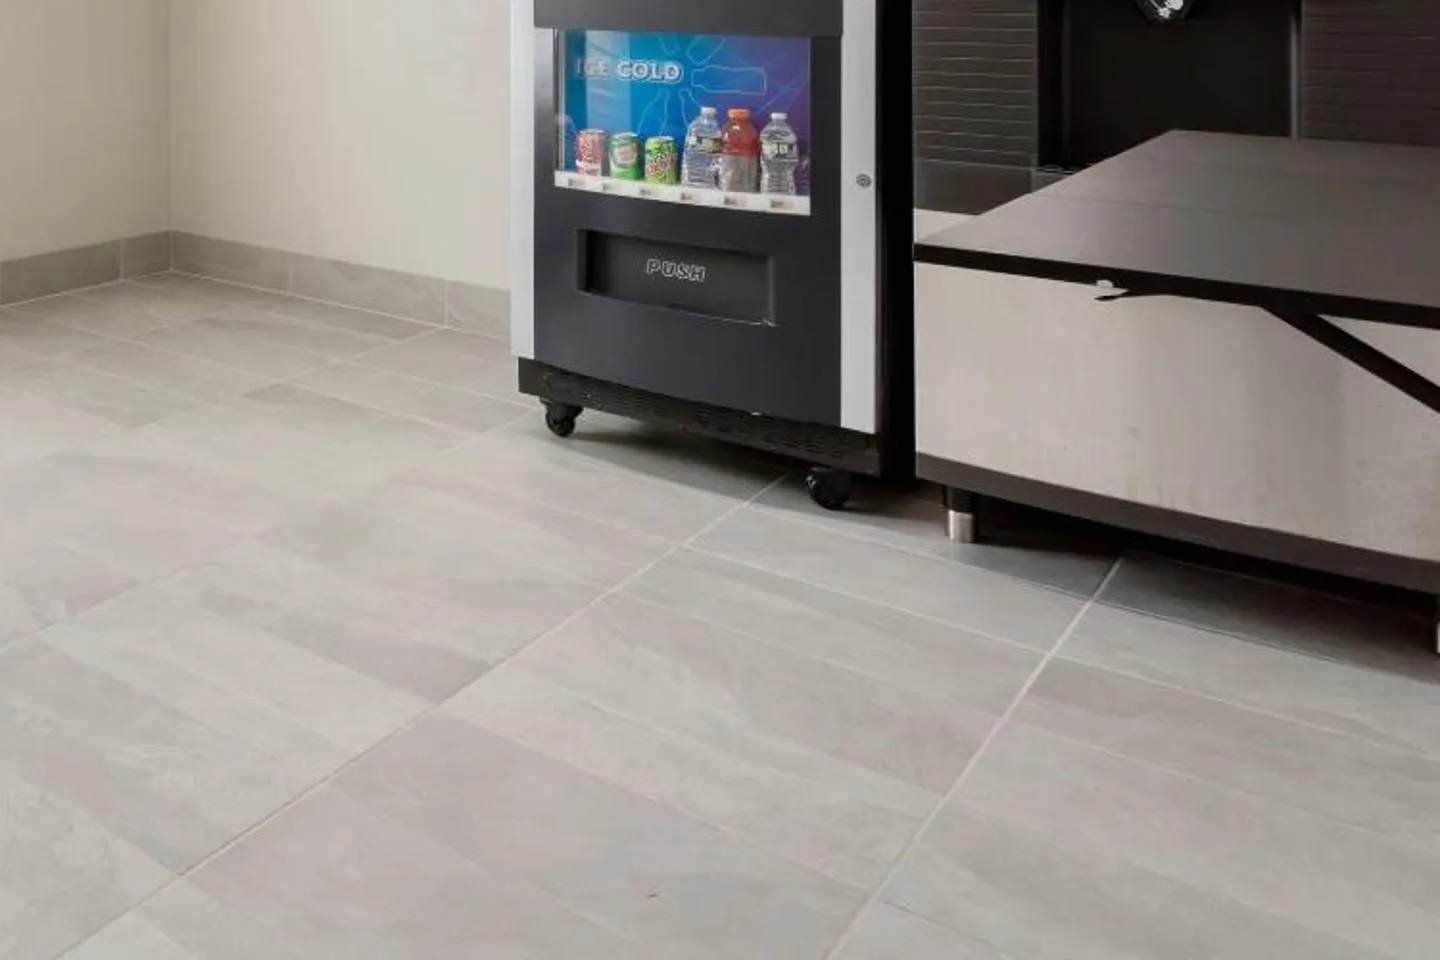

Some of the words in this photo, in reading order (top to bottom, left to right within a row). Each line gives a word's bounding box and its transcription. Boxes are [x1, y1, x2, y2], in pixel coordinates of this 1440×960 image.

[577, 59, 610, 77] ICE
[617, 60, 681, 81] COLD
[645, 258, 706, 282] PUSH
